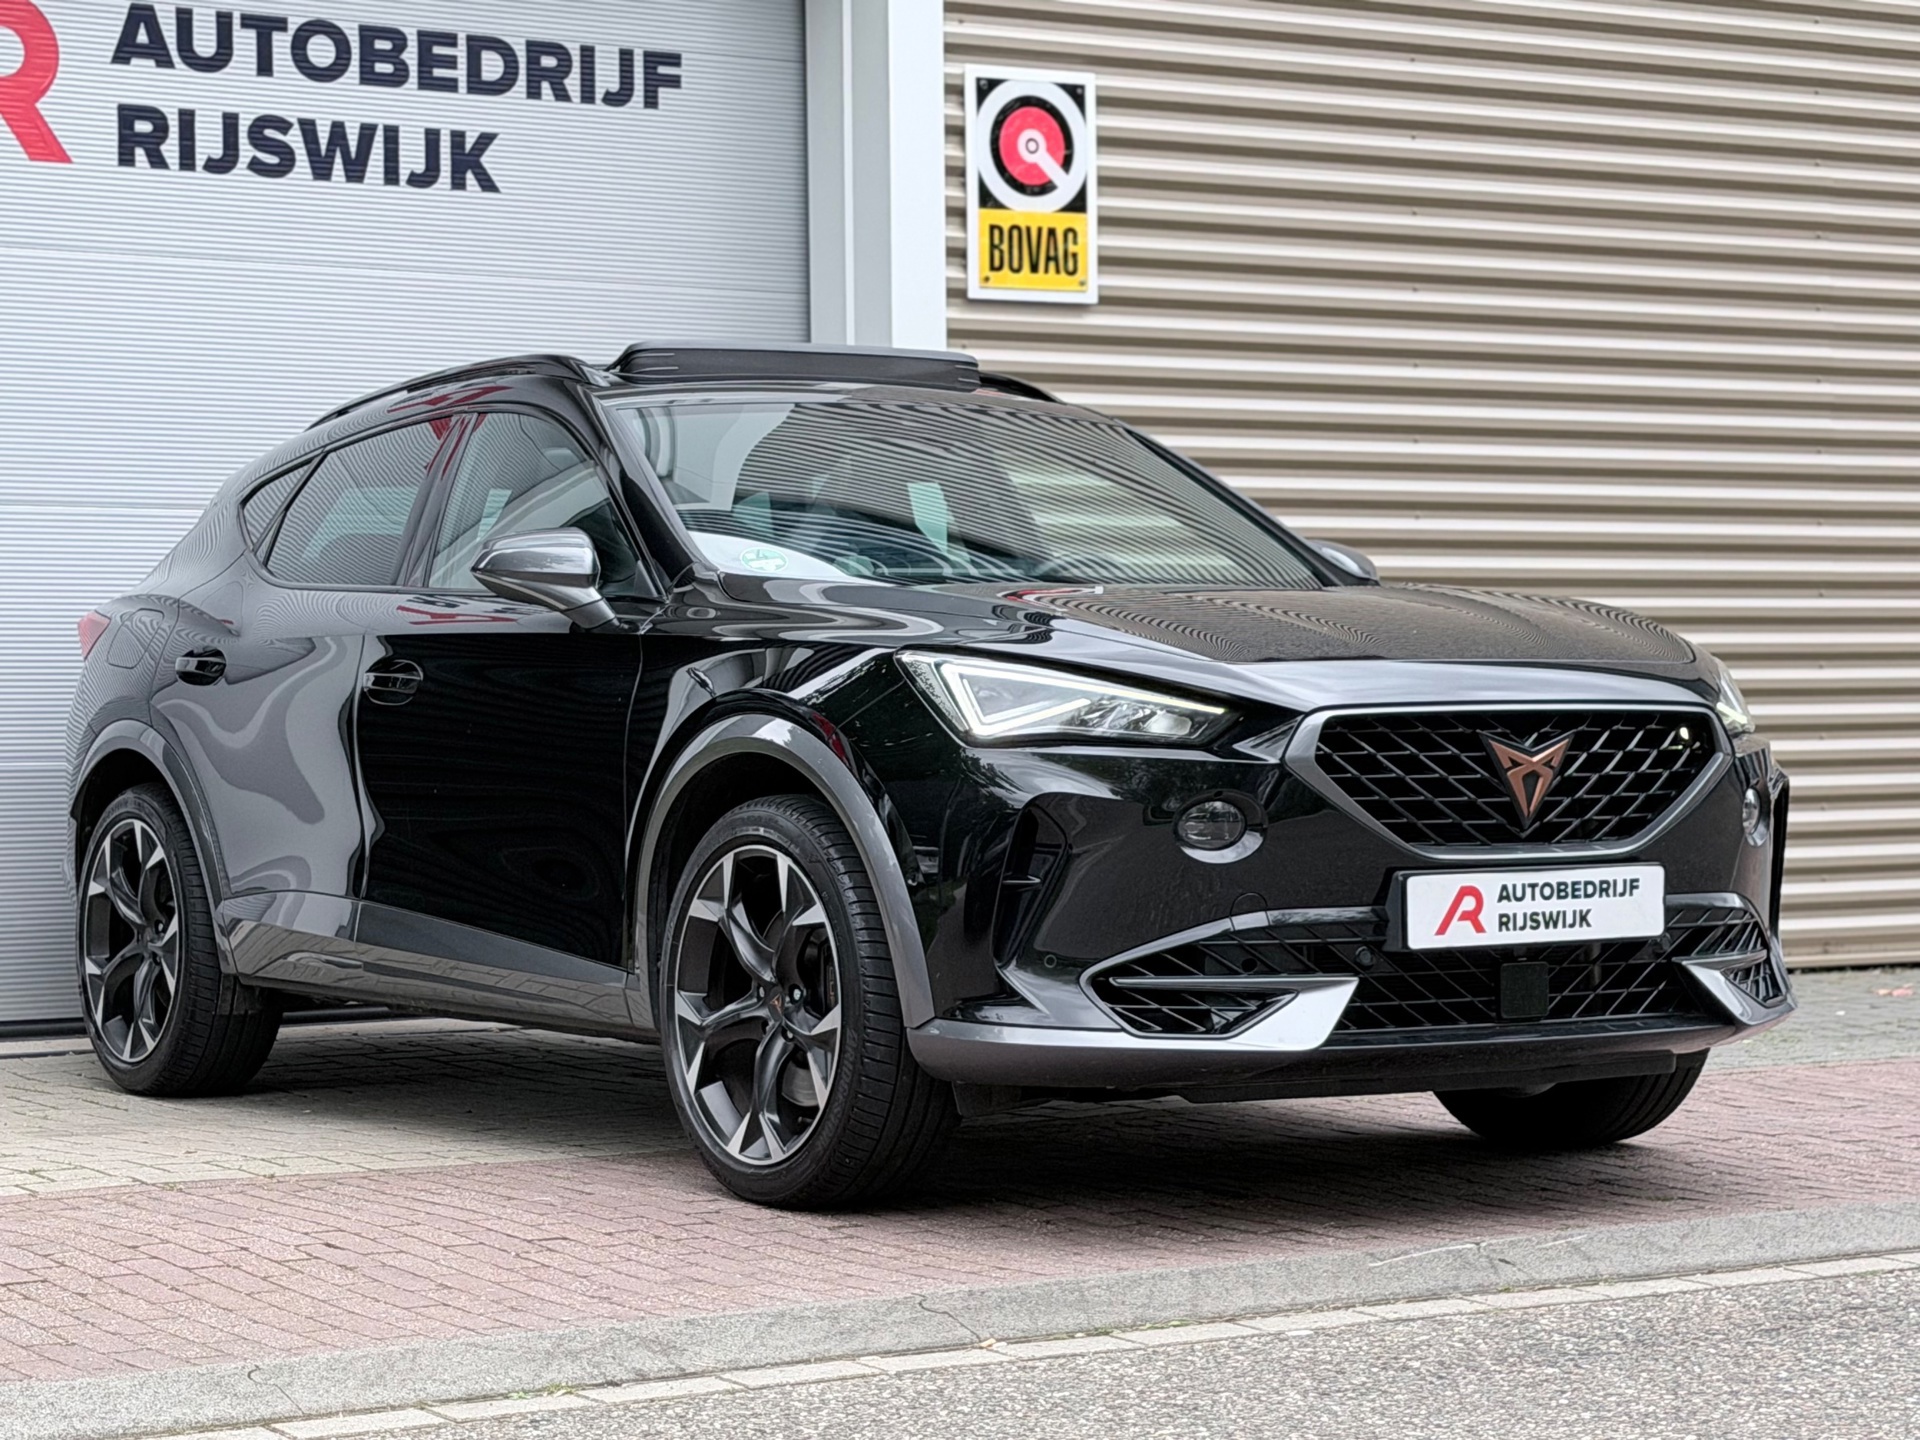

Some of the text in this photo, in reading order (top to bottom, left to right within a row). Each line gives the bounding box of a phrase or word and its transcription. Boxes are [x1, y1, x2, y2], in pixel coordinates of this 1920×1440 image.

[111, 2, 682, 112] AUTOBEDRIJF
[116, 103, 501, 193] RIJSWIJK
[988, 224, 1079, 277] BOVAG
[1497, 878, 1641, 904] AUTOBEDRIJF
[1498, 909, 1592, 932] RIJSWIJK
